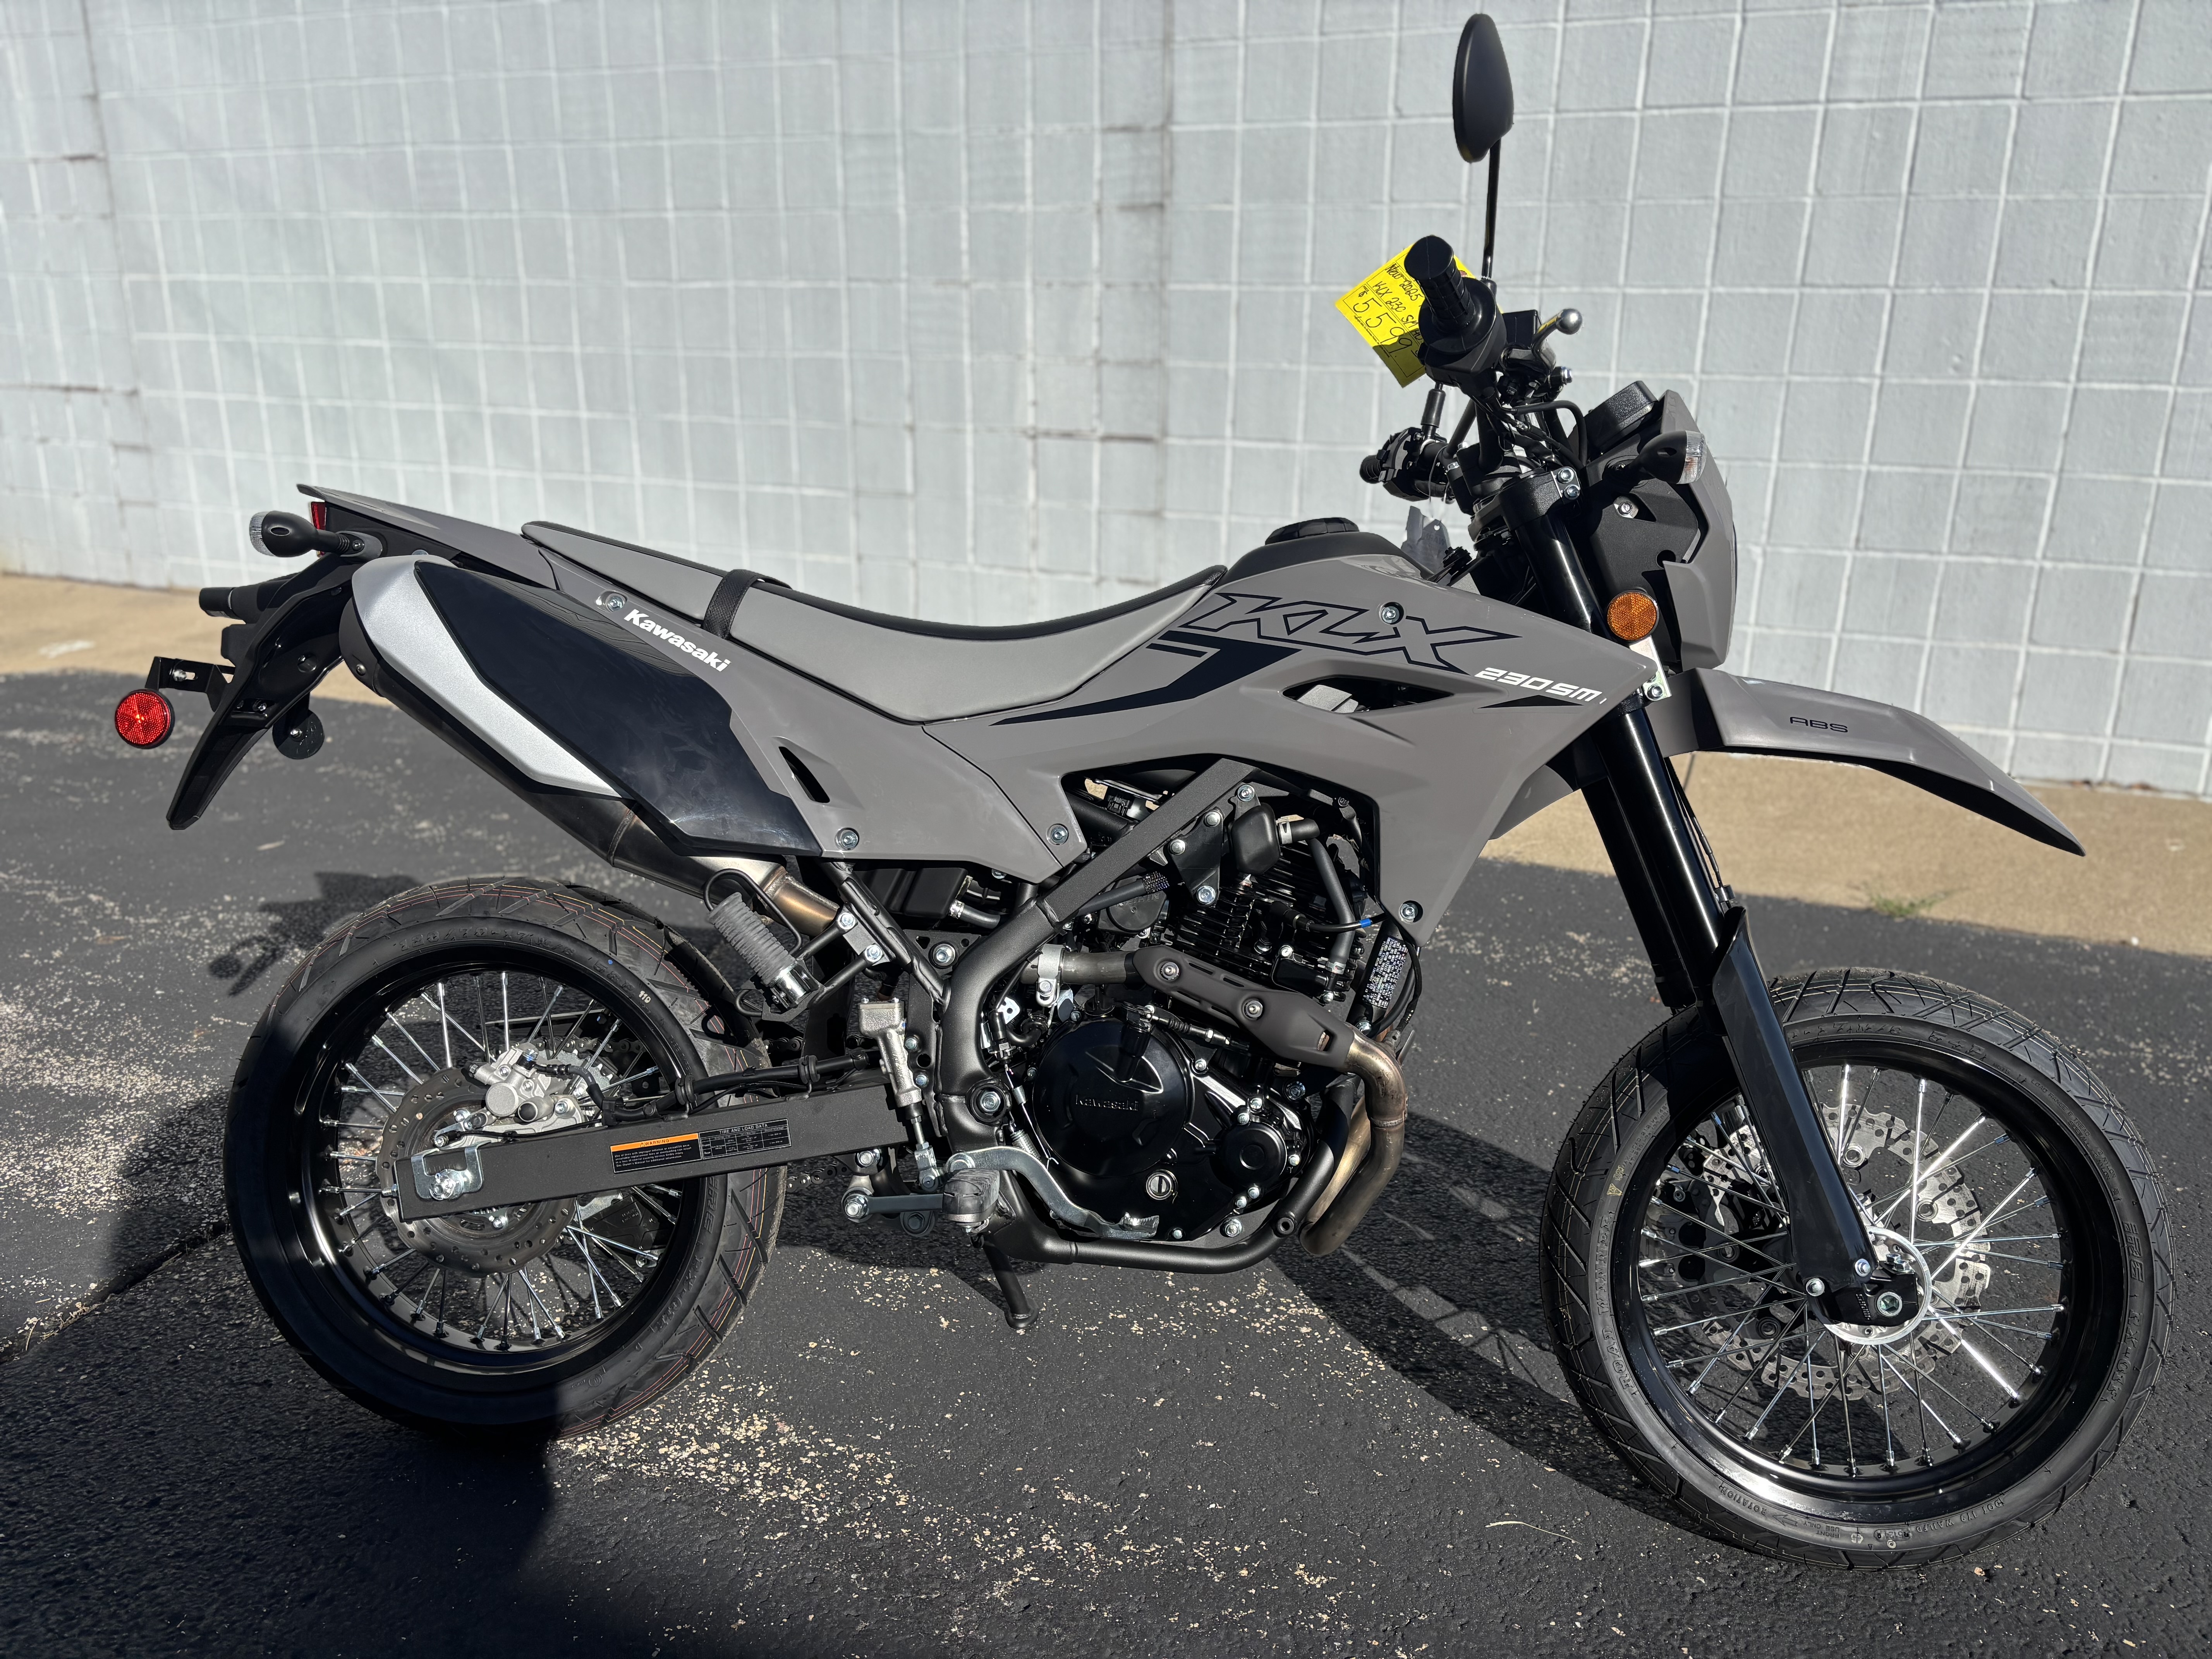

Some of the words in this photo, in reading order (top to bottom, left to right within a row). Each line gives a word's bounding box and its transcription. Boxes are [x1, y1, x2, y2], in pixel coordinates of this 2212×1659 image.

[623, 609, 732, 672] Kawasaki
[1178, 592, 1522, 675] KLX
[1790, 716, 1848, 733] ABS
[1602, 1326, 1635, 1389] ROAD
[1720, 1486, 1767, 1516] ROTATION
[1803, 1521, 1824, 1531] ONLY
[1816, 1529, 1840, 1539] FRONT
